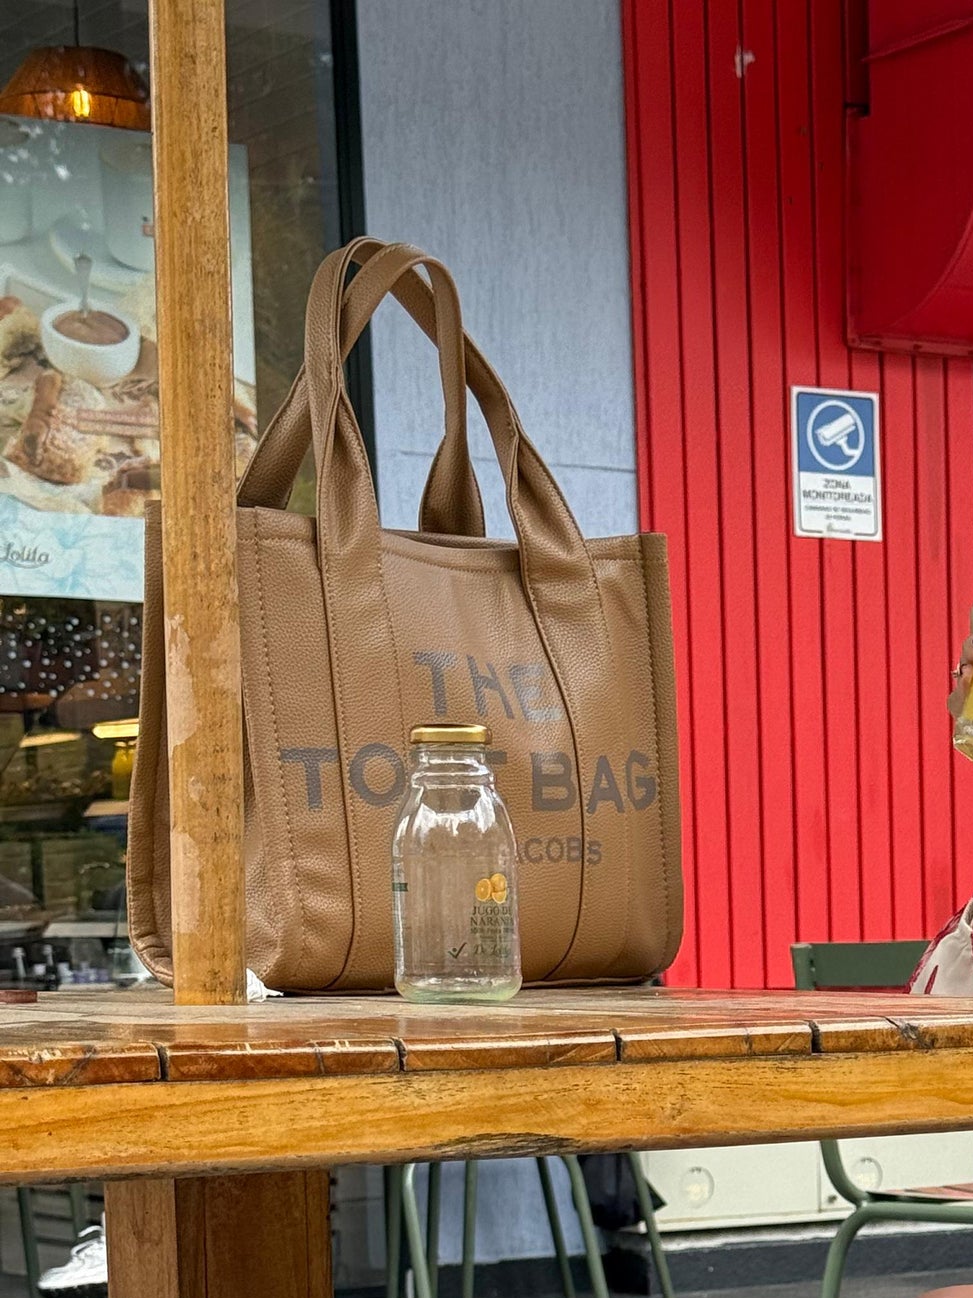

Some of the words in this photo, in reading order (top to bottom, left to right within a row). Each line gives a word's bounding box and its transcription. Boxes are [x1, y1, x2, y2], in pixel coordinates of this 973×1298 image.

[822, 478, 851, 489] ZONA
[413, 650, 564, 723] THE
[530, 749, 658, 814] BAG
